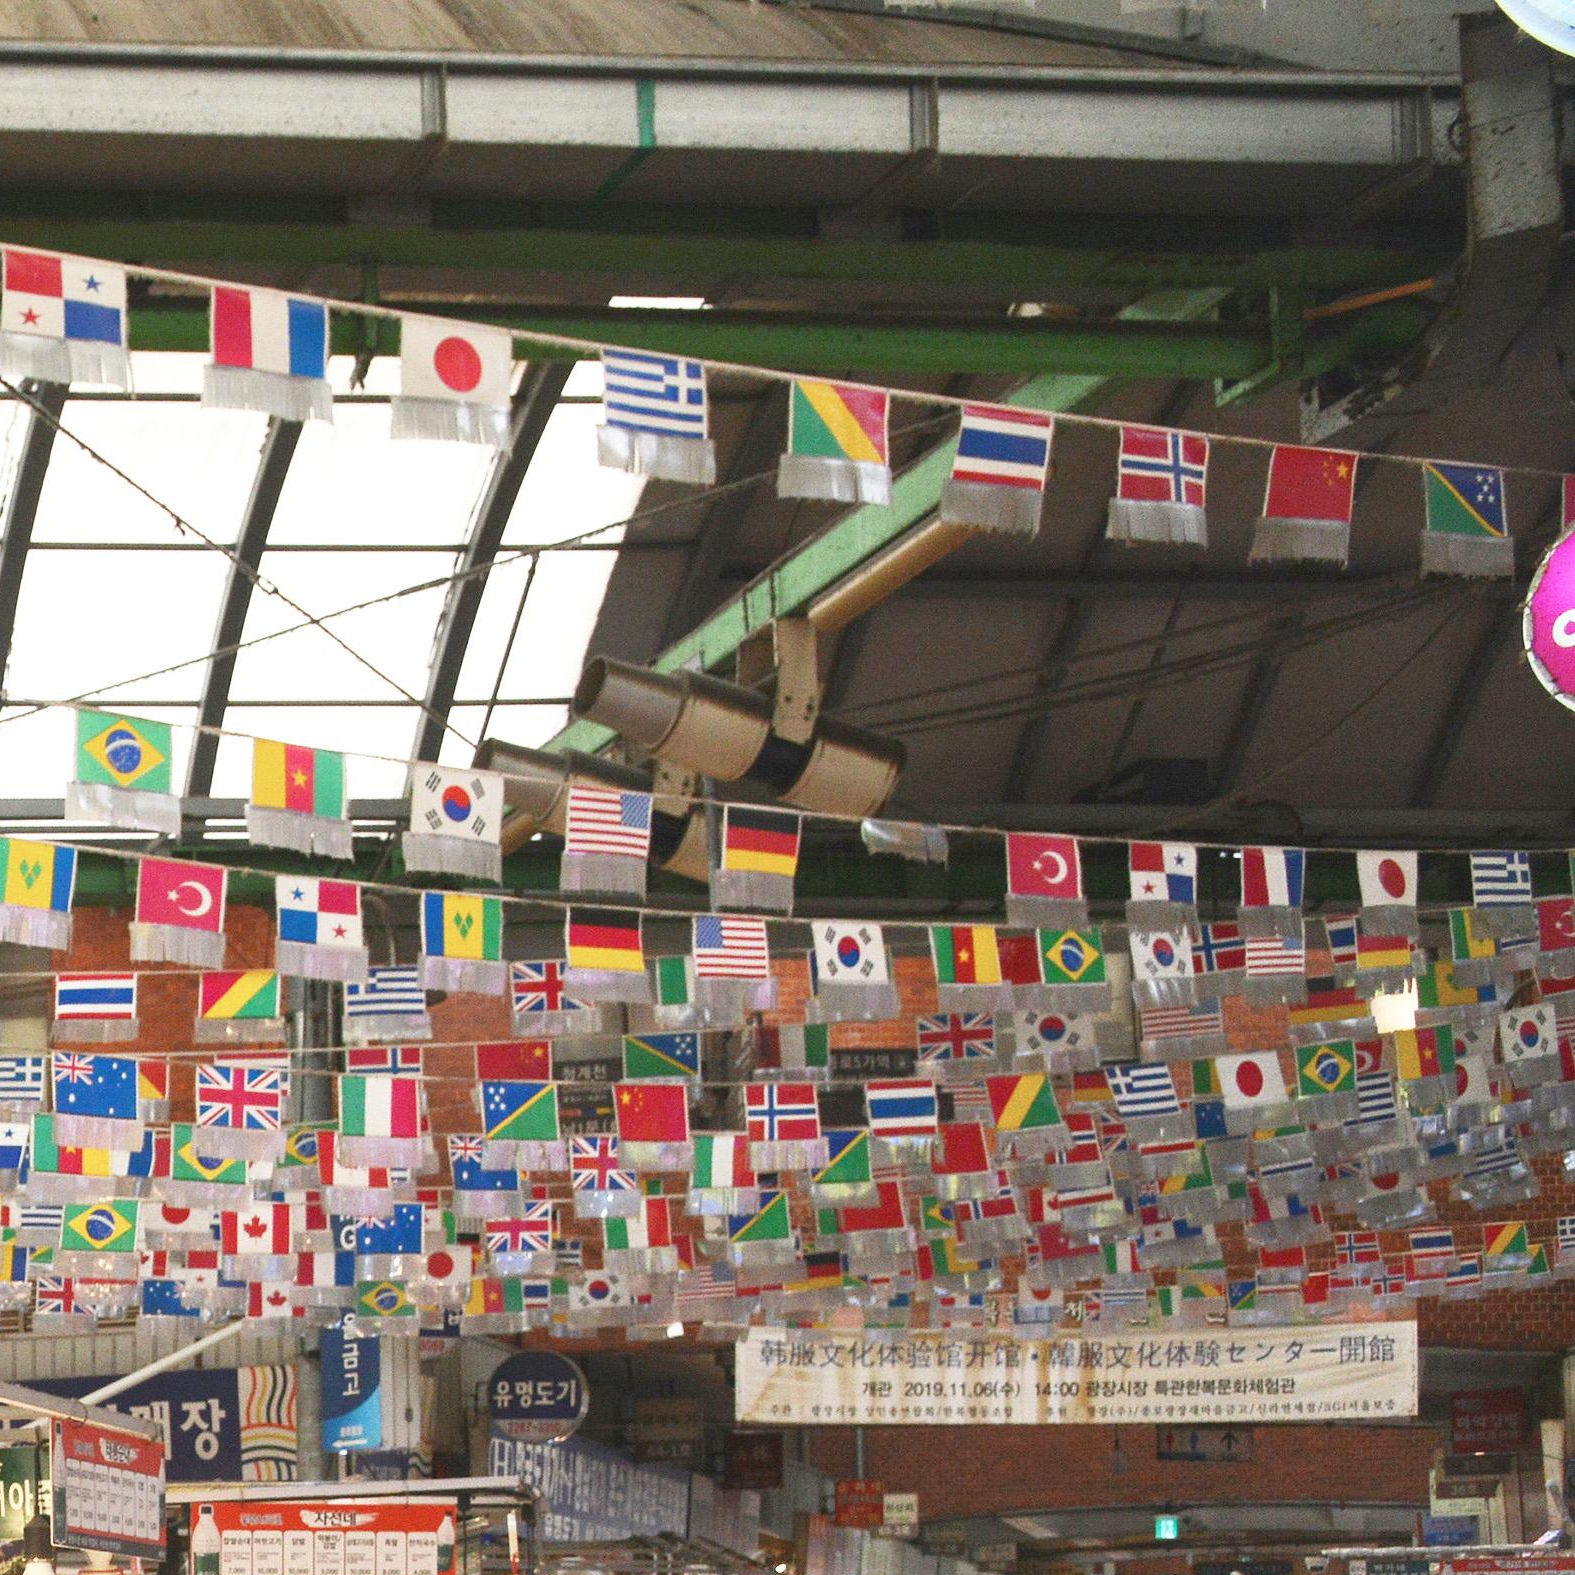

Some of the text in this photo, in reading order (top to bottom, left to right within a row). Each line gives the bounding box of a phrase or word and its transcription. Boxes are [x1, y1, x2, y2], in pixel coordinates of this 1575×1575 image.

[492, 1380, 576, 1408] 유명도기
[862, 1381, 892, 1399] 개관
[904, 1381, 1021, 1400] 2019.11.06(수)
[1034, 1381, 1080, 1399] 14:00
[1085, 1379, 1149, 1398] 광장시장
[127, 1398, 227, 1461] 매장
[315, 1511, 357, 1526] 자선네
